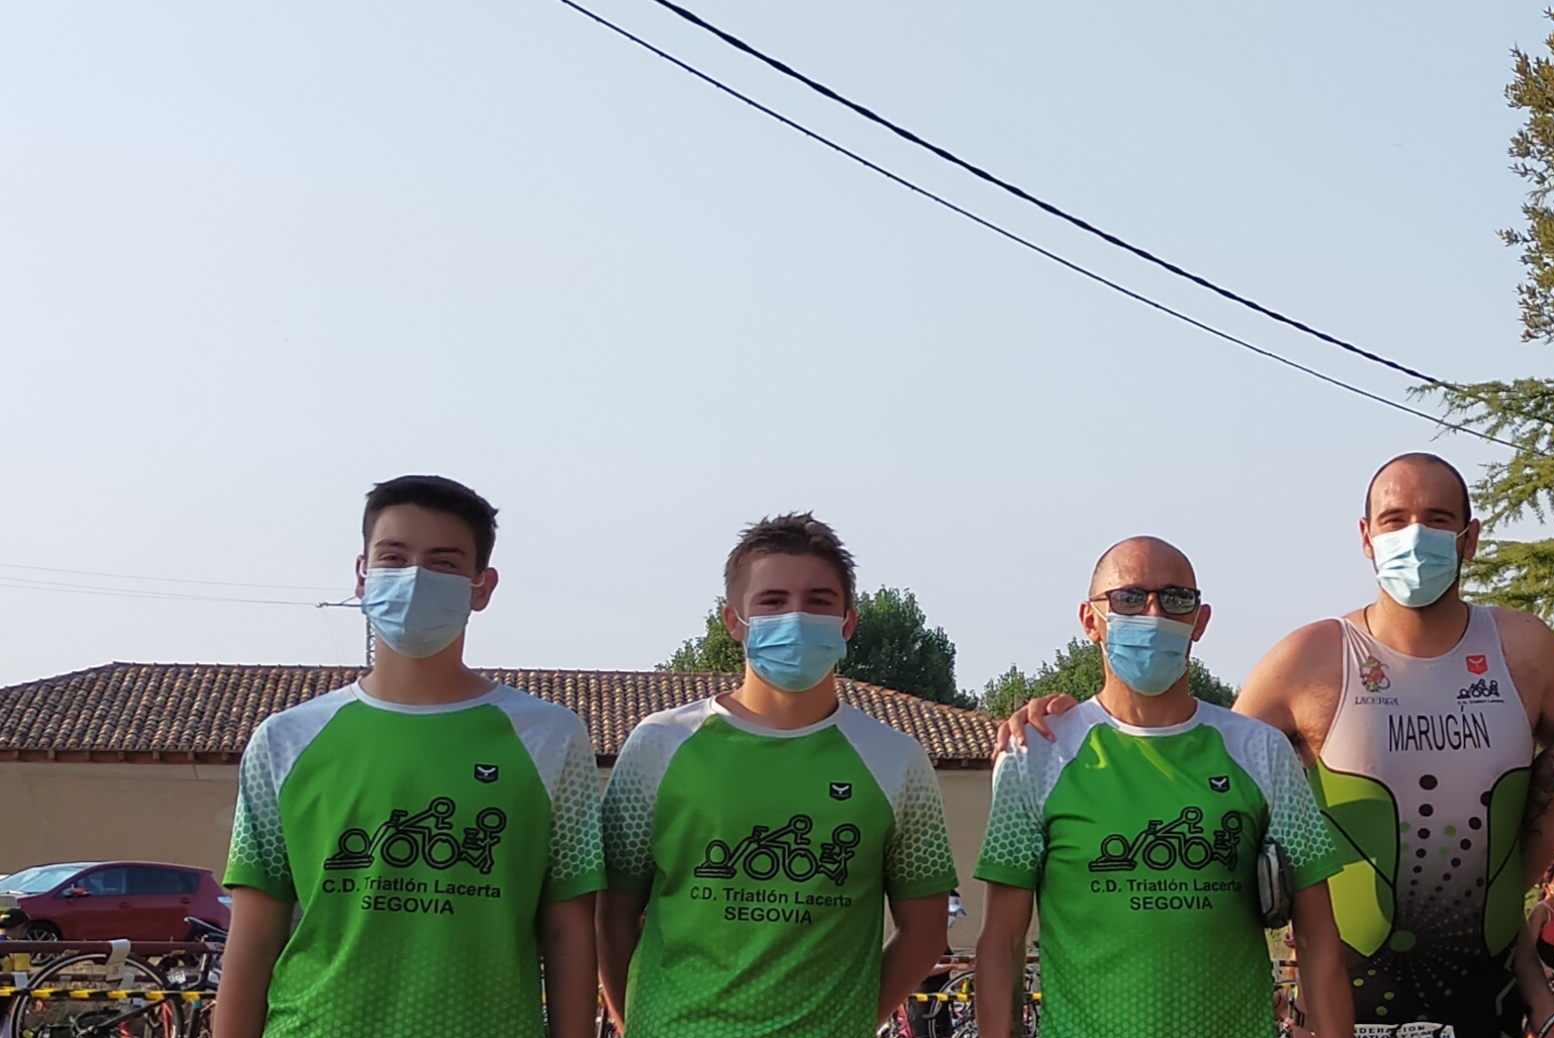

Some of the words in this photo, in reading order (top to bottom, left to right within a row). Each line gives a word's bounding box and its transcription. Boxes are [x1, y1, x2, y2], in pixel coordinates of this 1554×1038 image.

[1388, 705, 1491, 752] MARUGÁN
[322, 878, 360, 893] C.D.
[364, 876, 428, 893] Triatlón
[434, 880, 501, 898] Lacerta
[1090, 879, 1122, 893] C.D.
[1126, 878, 1188, 892] Triatlón
[1194, 879, 1242, 892] Lacerta
[361, 896, 454, 915] SEGOVIA
[690, 886, 717, 901] C.D.
[723, 887, 788, 904] Triatlón
[794, 891, 852, 908] Lacerta
[1130, 896, 1213, 910] SEGOVIA
[724, 906, 812, 924] SEGOVIA
